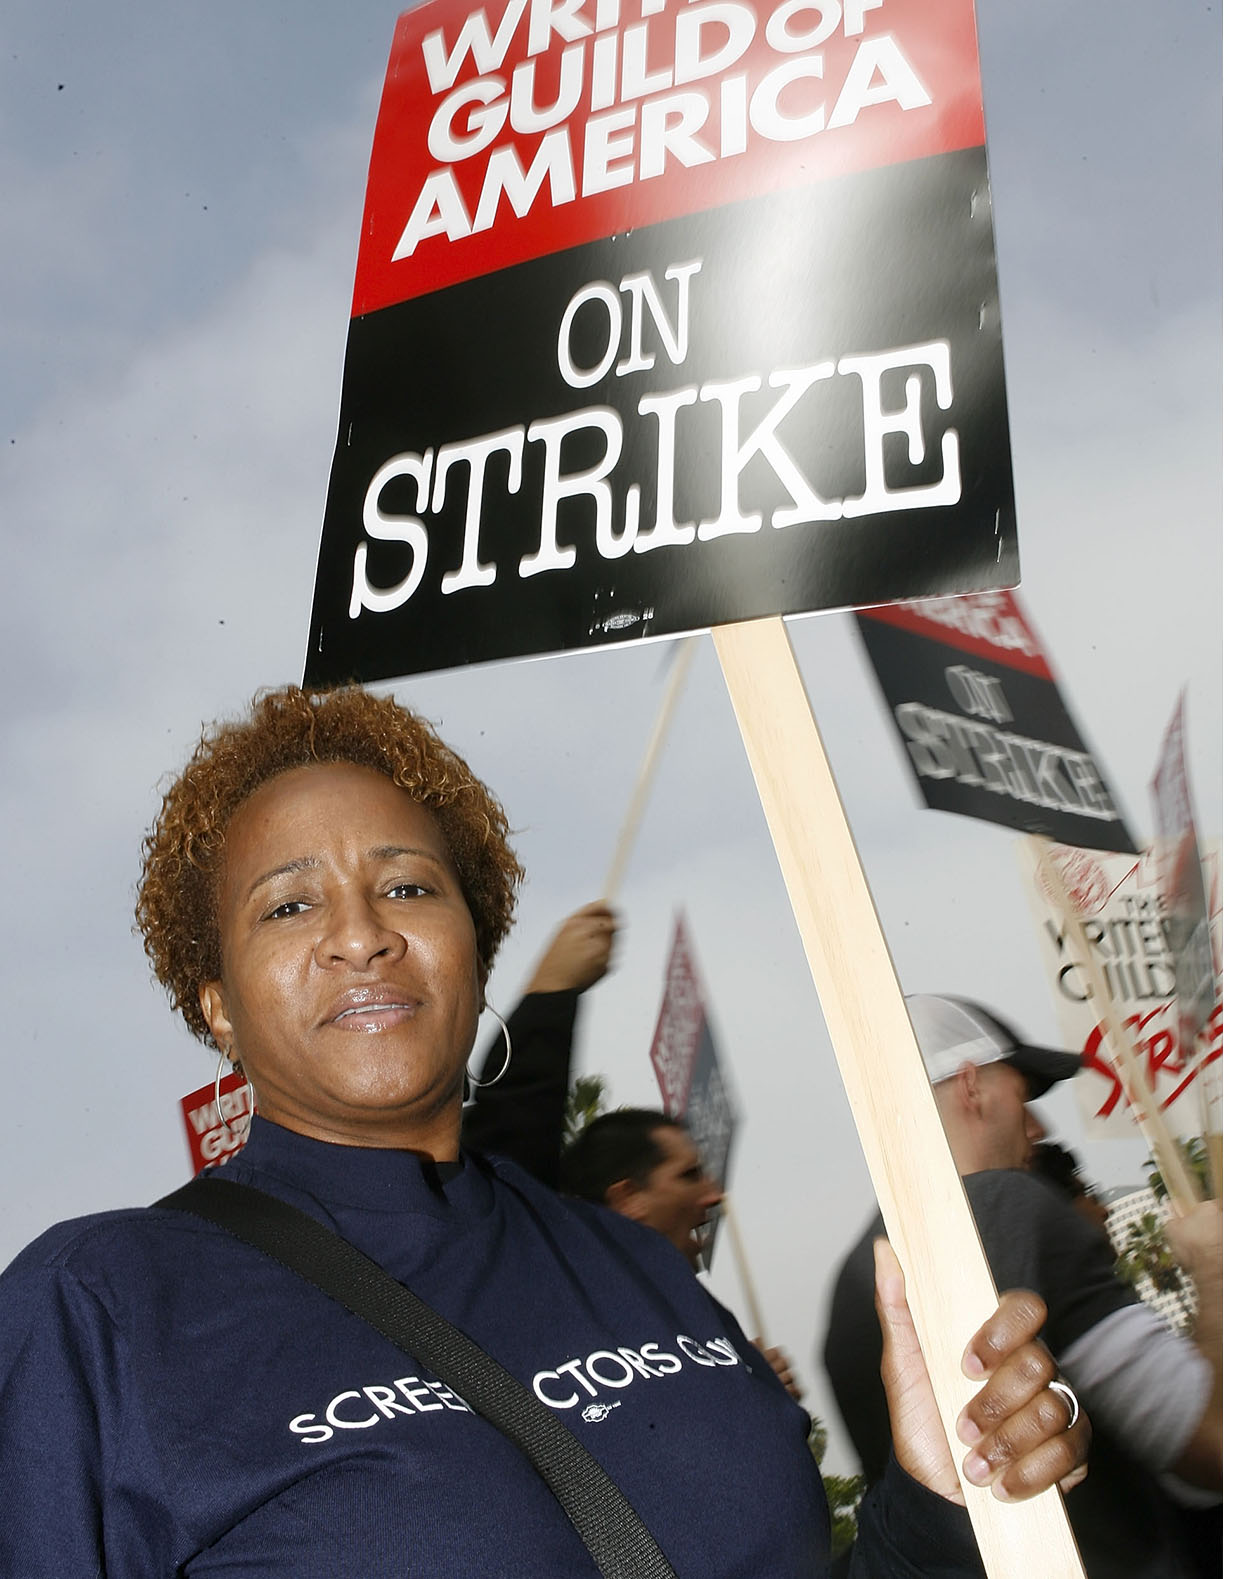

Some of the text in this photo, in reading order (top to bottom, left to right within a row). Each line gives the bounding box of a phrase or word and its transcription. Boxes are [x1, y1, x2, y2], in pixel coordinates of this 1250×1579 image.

[391, 35, 934, 263] AMERICA
[427, 2, 758, 164] GUILD
[557, 258, 702, 389] ON
[348, 339, 962, 619] STRIKE
[895, 700, 1119, 822] STRIKE
